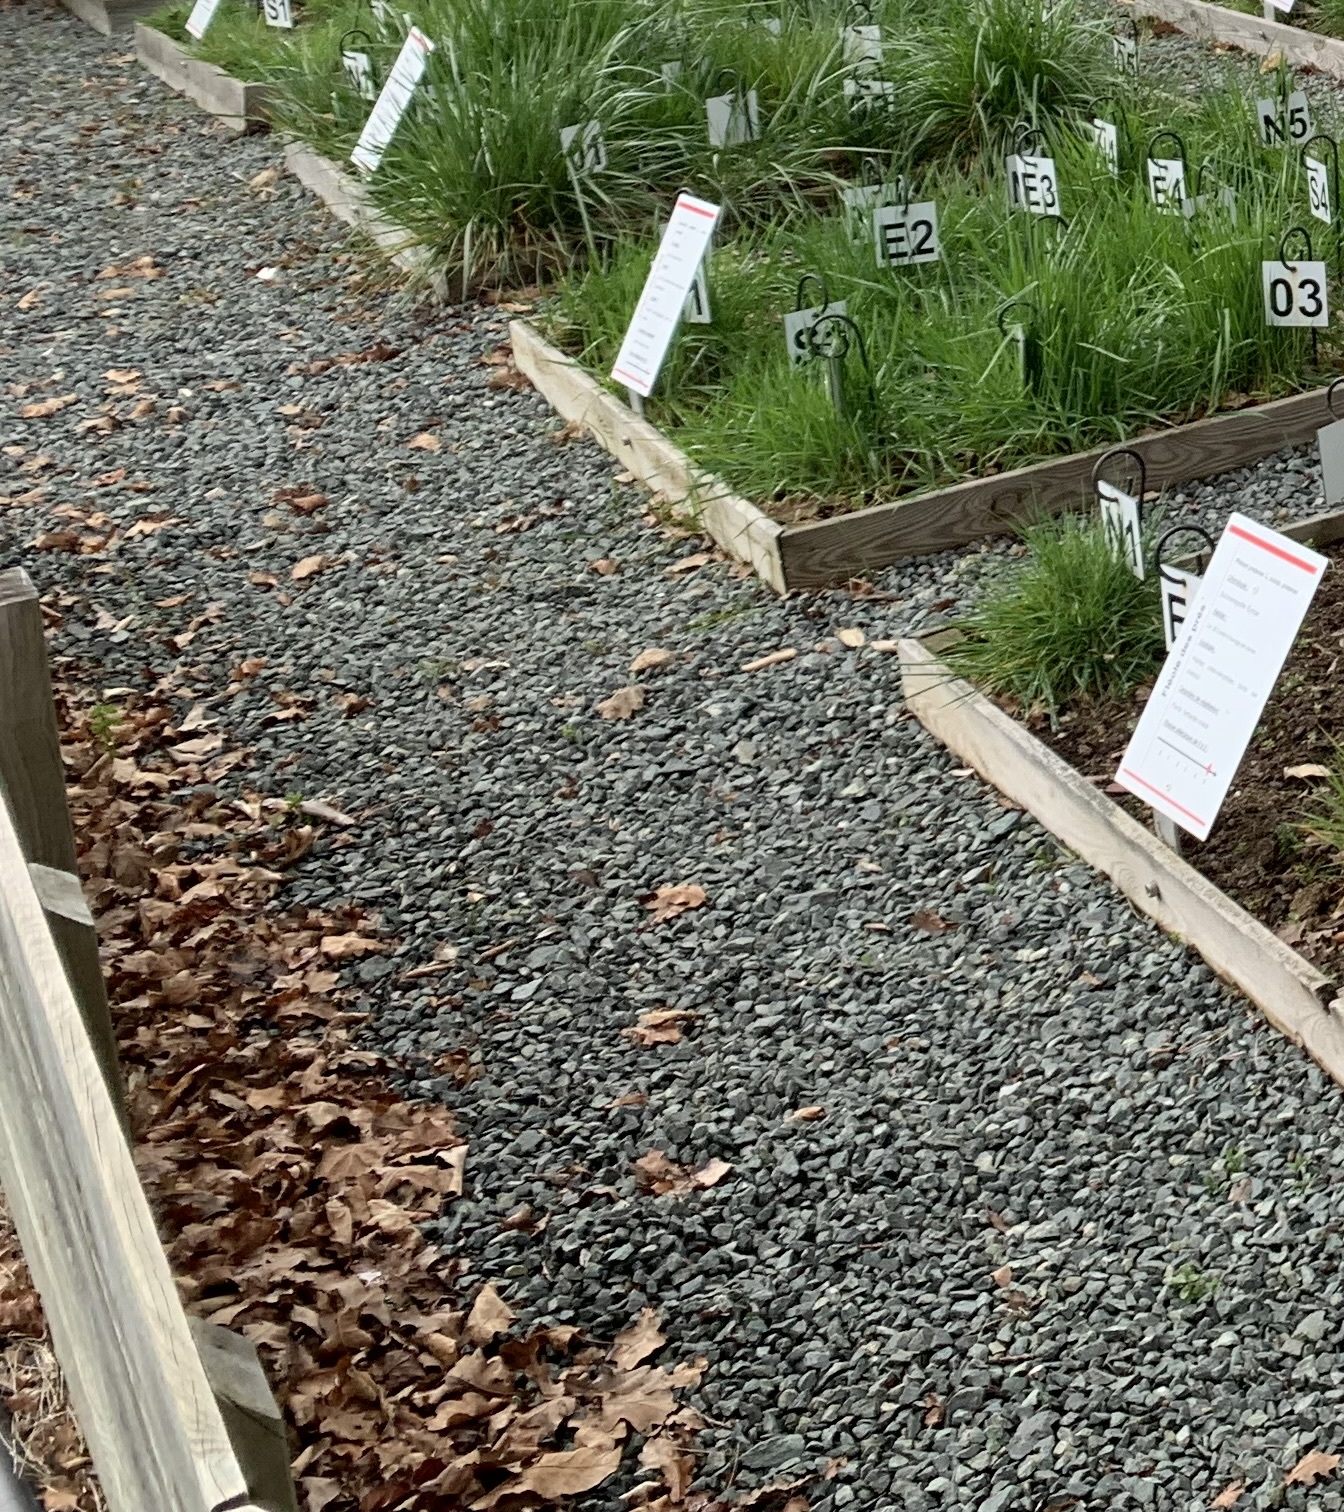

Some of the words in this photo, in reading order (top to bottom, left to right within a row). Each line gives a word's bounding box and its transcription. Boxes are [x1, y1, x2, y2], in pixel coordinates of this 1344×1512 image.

[1264, 107, 1308, 144] N5
[1022, 173, 1056, 208] E3
[1154, 175, 1184, 210] E4
[1310, 176, 1328, 215] S4
[882, 219, 934, 259] E2
[1270, 278, 1323, 318] 03
[1105, 506, 1138, 567] N1
